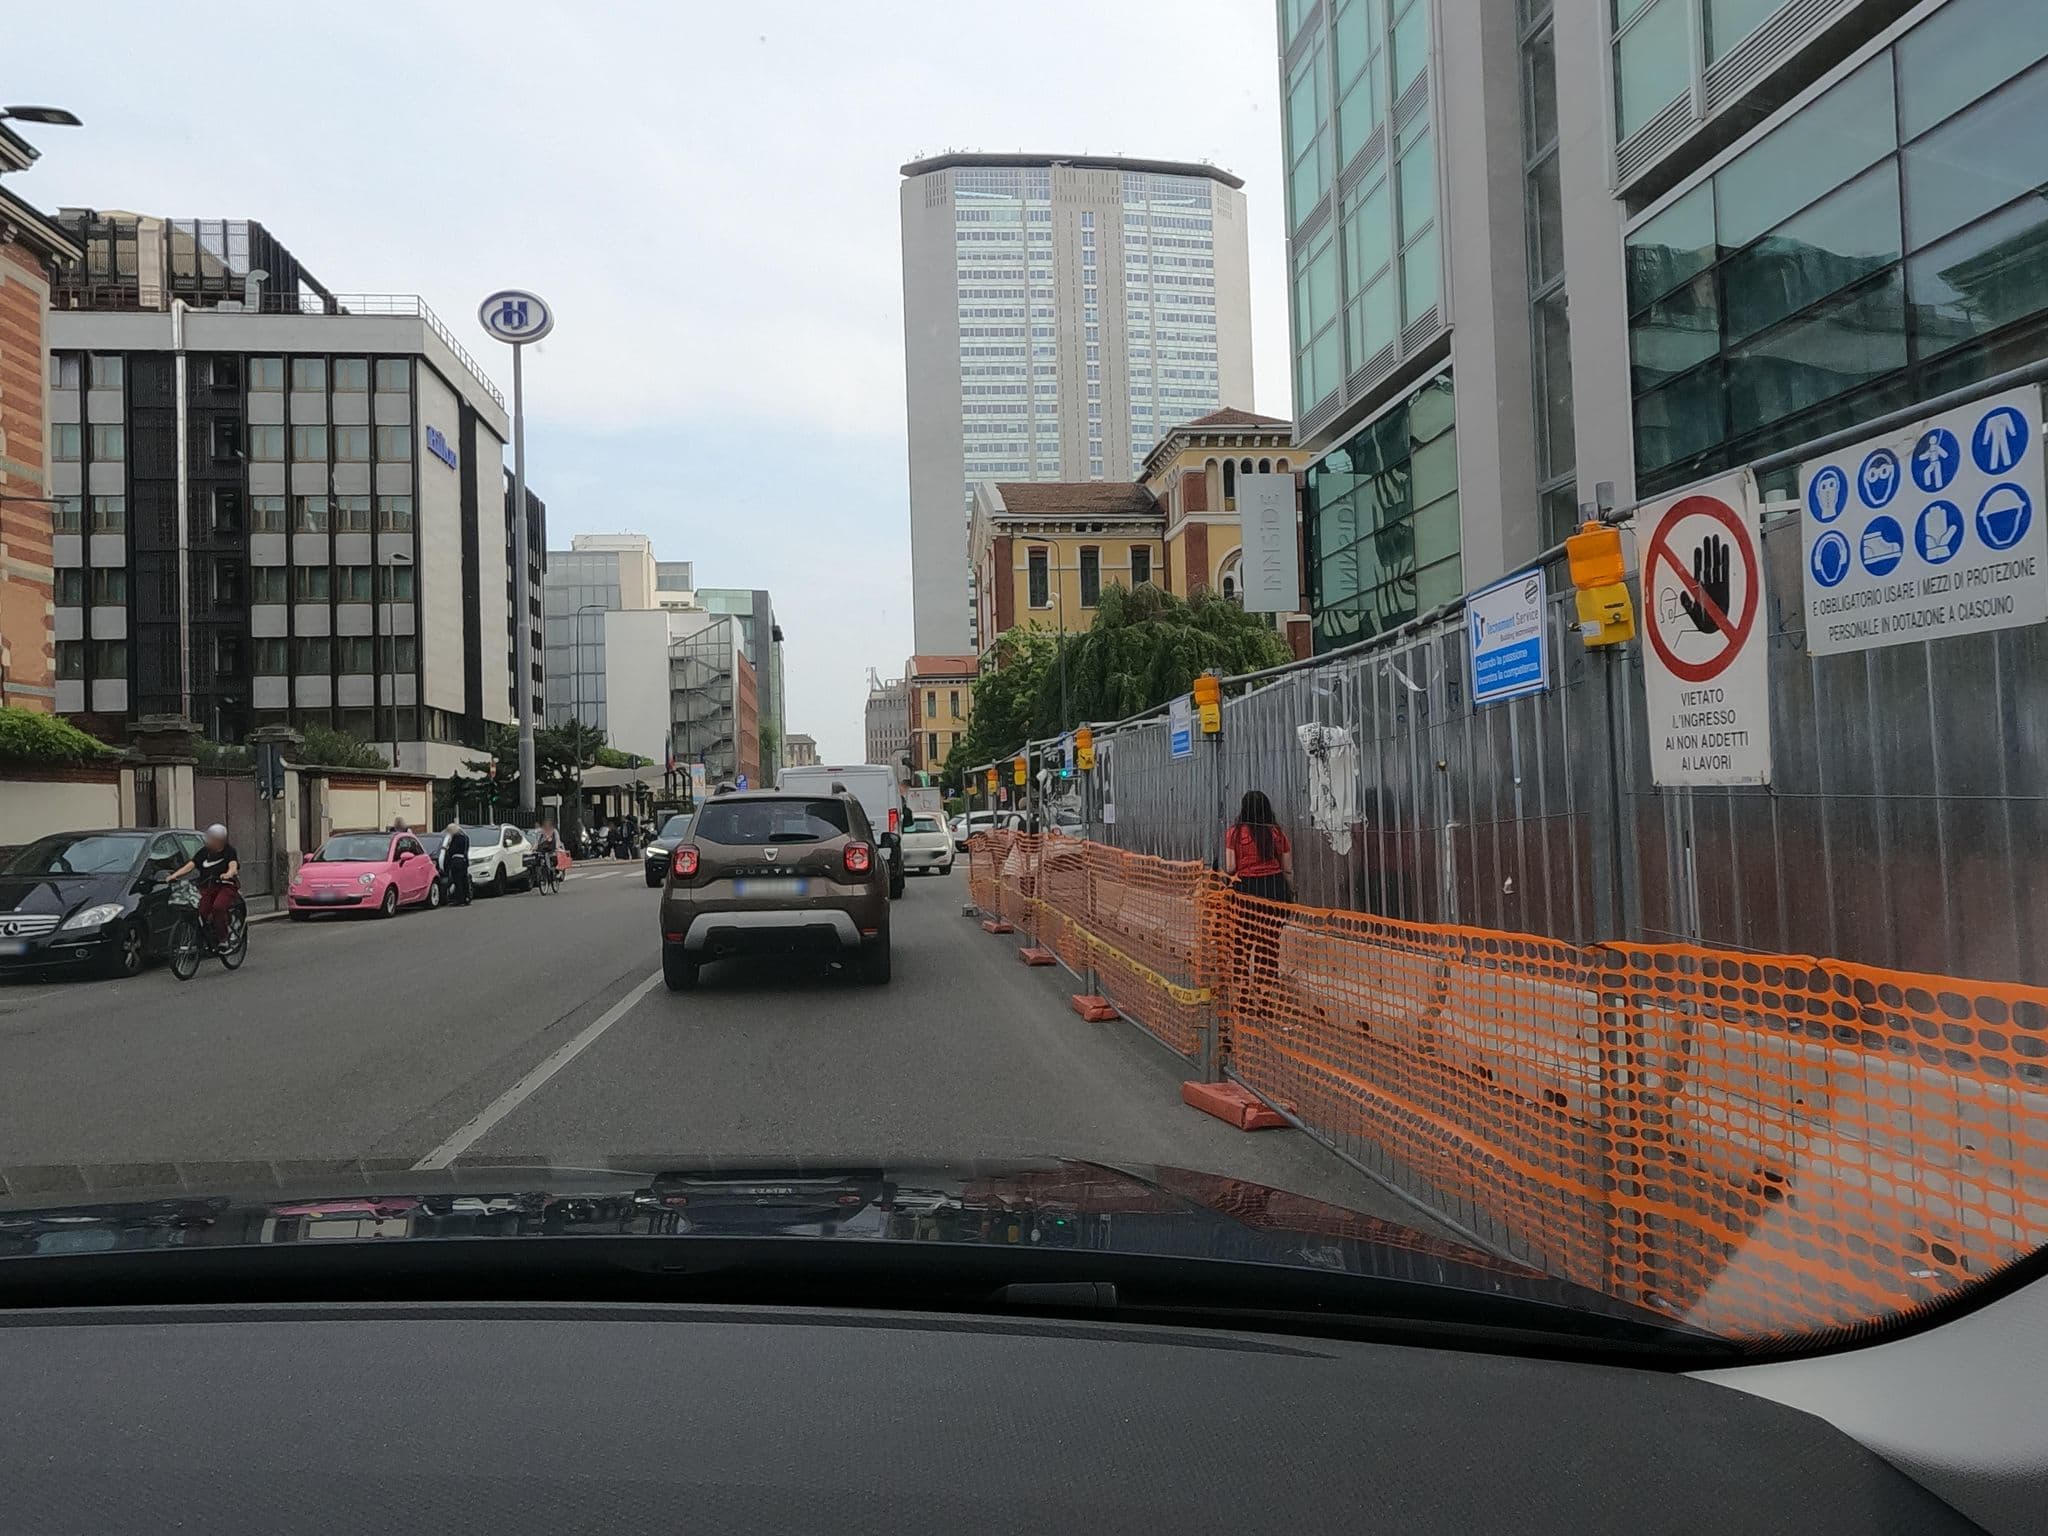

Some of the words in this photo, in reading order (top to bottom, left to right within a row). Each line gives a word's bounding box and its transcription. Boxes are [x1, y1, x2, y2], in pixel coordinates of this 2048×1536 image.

[425, 425, 457, 470] Hilton
[1260, 491, 1282, 592] INNSIDE
[1820, 588, 1882, 616] OBBLIGATORIO
[1884, 581, 1915, 604] USARE
[1923, 573, 1951, 596] MEZZI
[1954, 571, 1964, 590] DI
[1966, 556, 2036, 588] PROTEZIONE
[1515, 609, 1539, 626] Service
[1828, 618, 1879, 641] PERSONALE
[1881, 616, 1891, 634] IN
[1892, 606, 1946, 632] DOTAZIONE
[1949, 604, 1956, 622] A
[1958, 595, 2014, 621] CIASCUNO
[1680, 688, 1724, 706] VIETATO
[1672, 709, 1736, 729] L'INGRESSO
[1665, 737, 1675, 751] AI
[1677, 734, 1698, 750] NON
[1701, 731, 1748, 748] ADDETTI
[1681, 756, 1691, 771] AI
[1693, 755, 1732, 770] LAVORI
